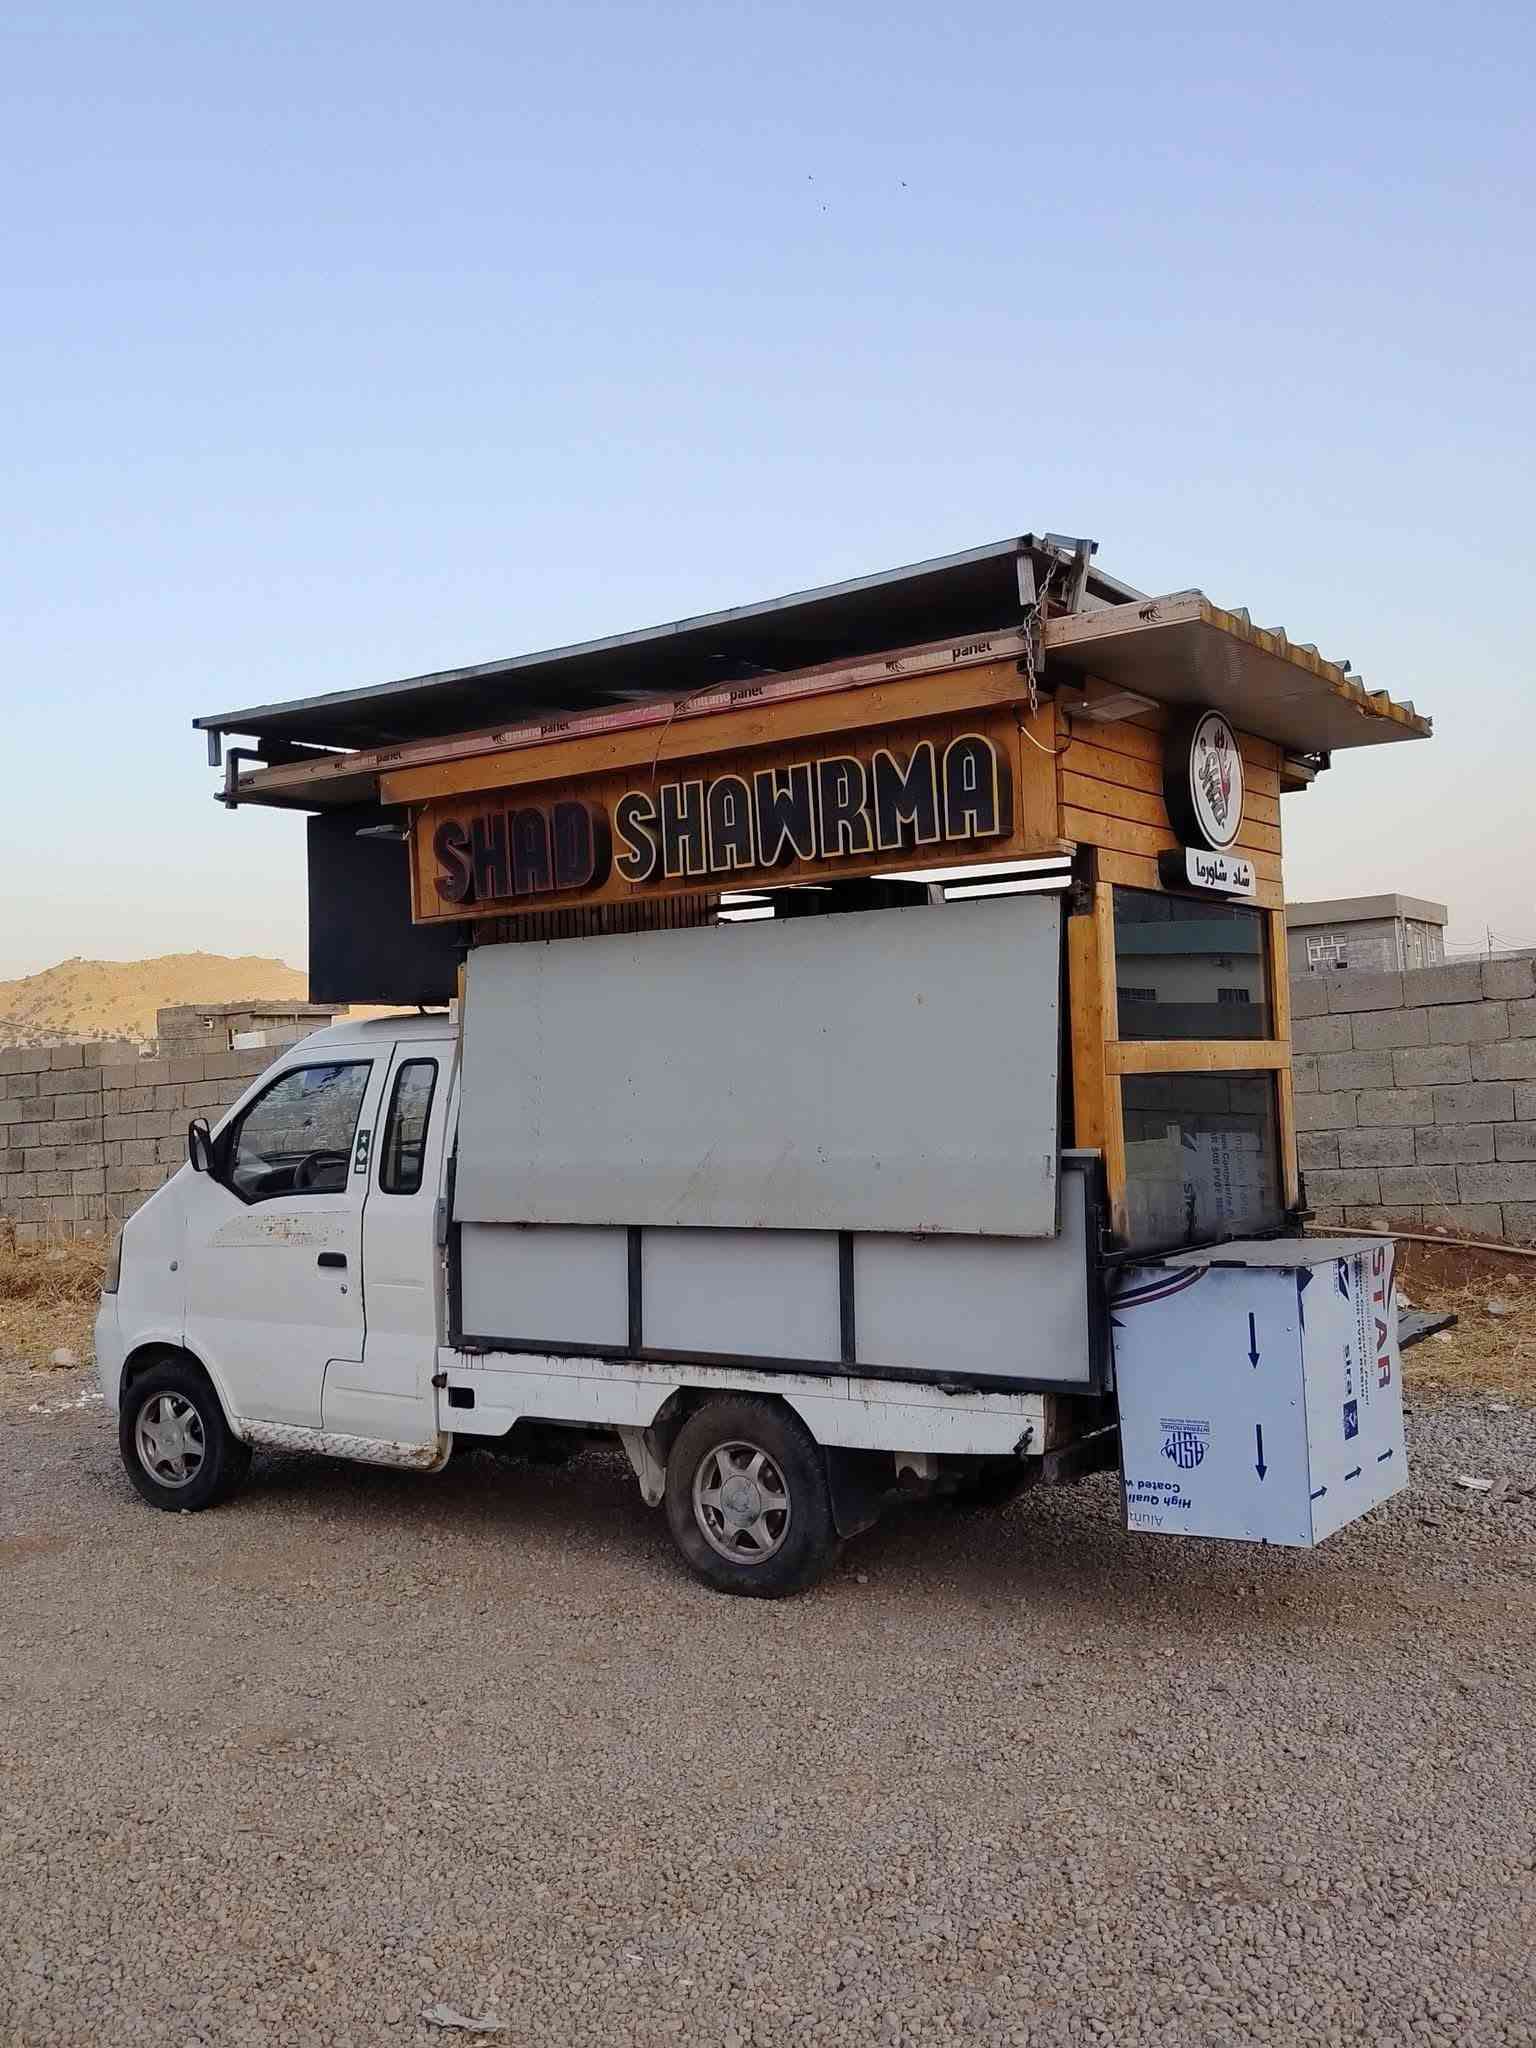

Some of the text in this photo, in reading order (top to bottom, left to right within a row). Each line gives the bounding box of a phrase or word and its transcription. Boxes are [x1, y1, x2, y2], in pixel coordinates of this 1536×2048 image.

[433, 733, 1001, 904] SHAD SHAWRMA
[1196, 856, 1250, 888] شاد شاورما
[1372, 1246, 1391, 1389] STAR
[1162, 1431, 1205, 1469] ASTM
[1138, 1480, 1181, 1493] Coated
[1163, 1496, 1192, 1509] High
